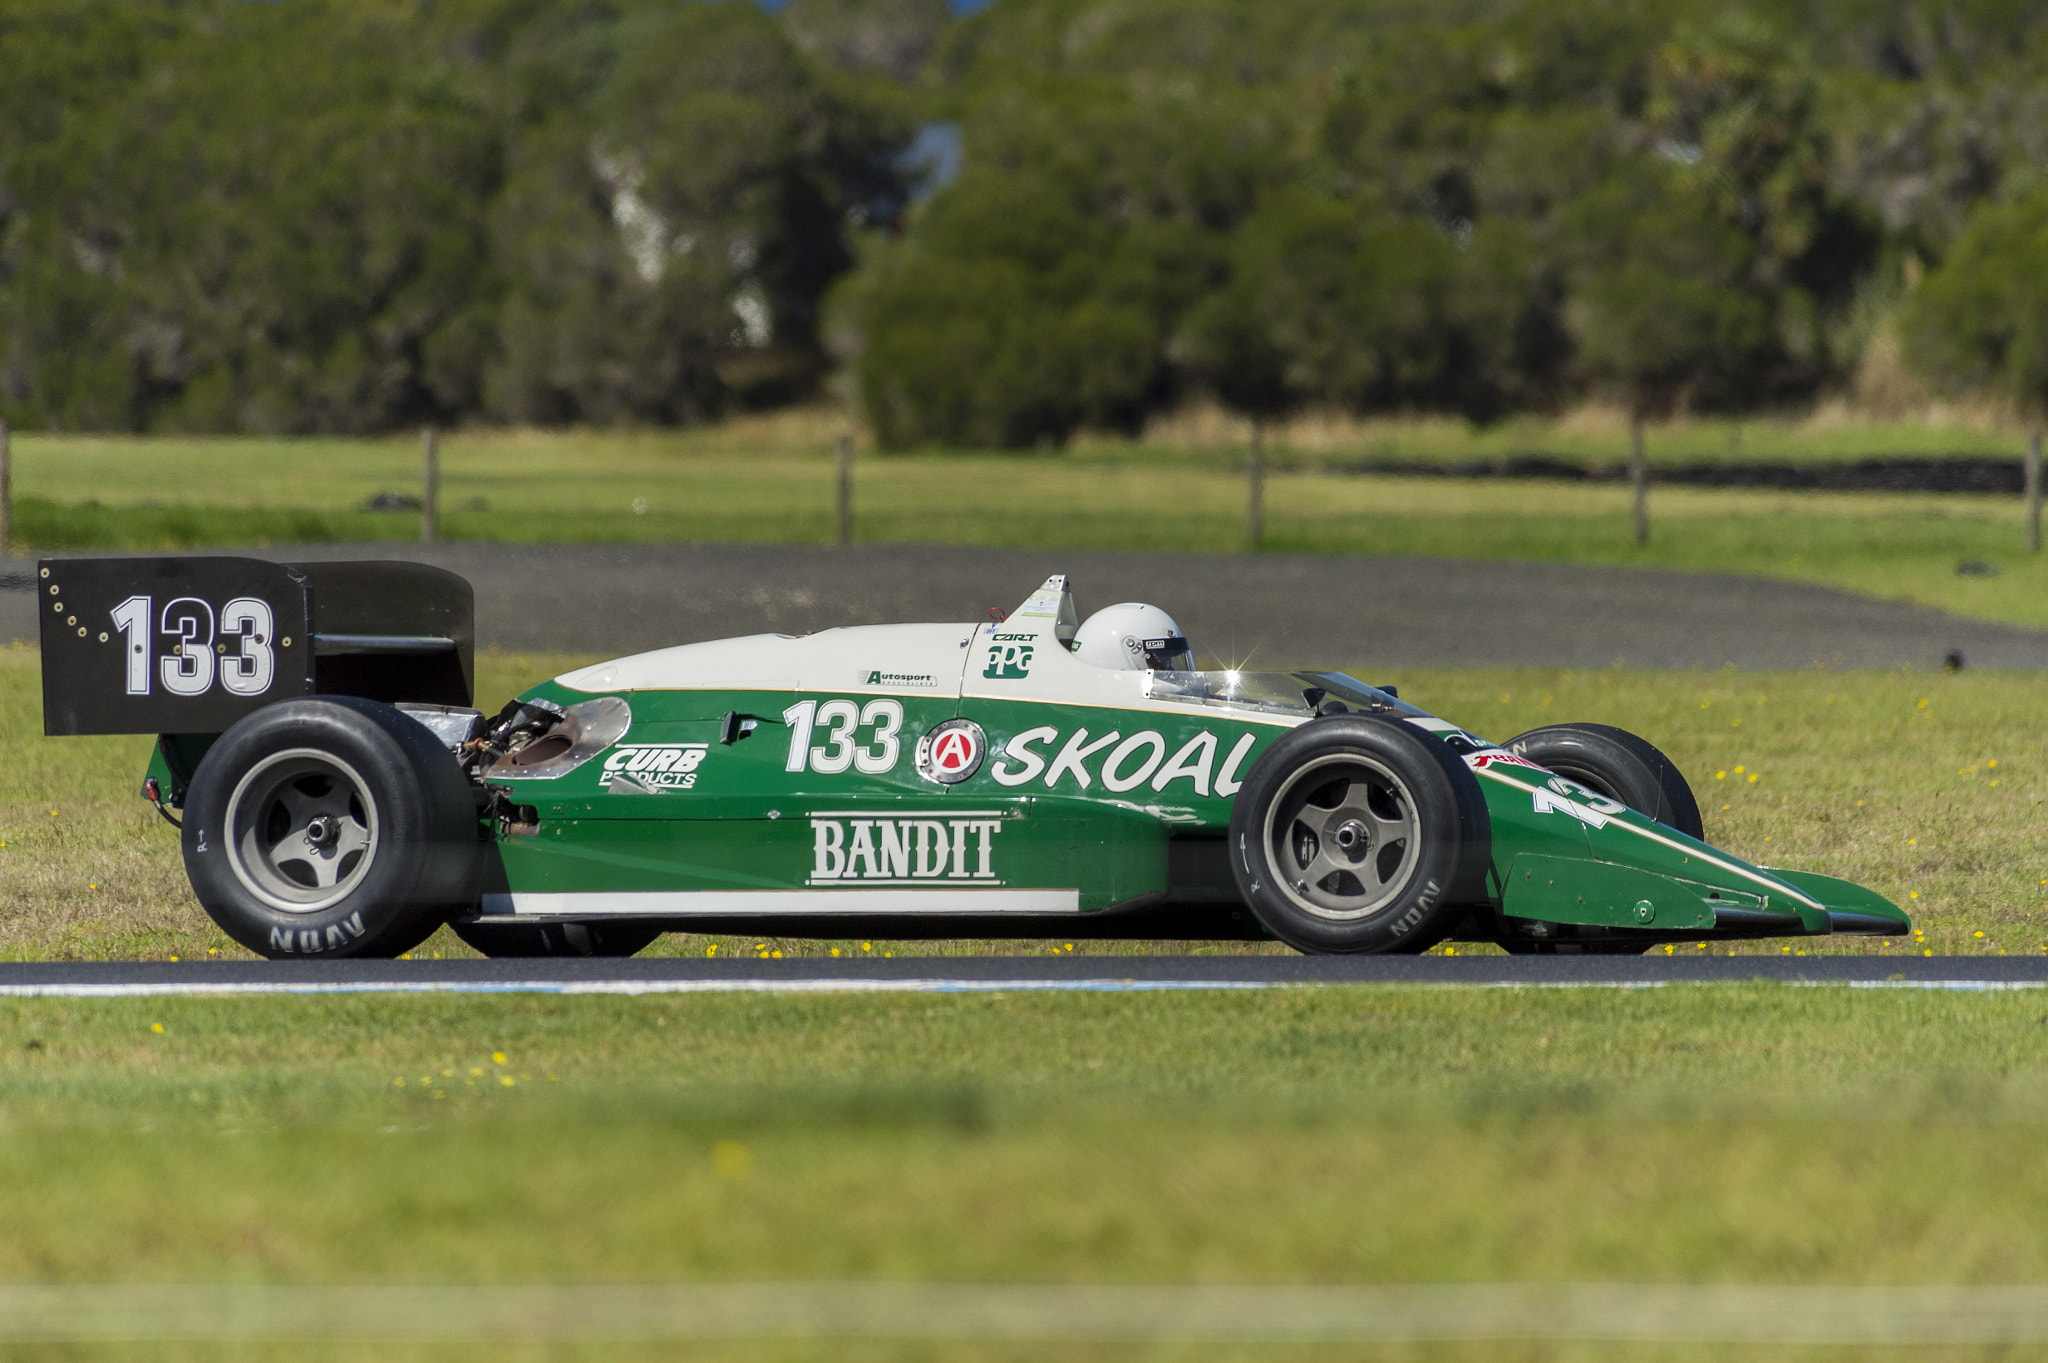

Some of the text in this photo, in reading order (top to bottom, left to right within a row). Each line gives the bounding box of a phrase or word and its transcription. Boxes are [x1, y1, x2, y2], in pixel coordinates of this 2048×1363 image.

[110, 596, 274, 696] 133
[992, 634, 1039, 642] CART
[866, 670, 931, 684] Autosport
[604, 748, 707, 773] CURB
[782, 699, 904, 774] 133
[990, 726, 1257, 799] SKOAL
[810, 818, 1002, 880] BANDIT
[270, 910, 366, 954] AVON
[1390, 879, 1442, 938] AVON
